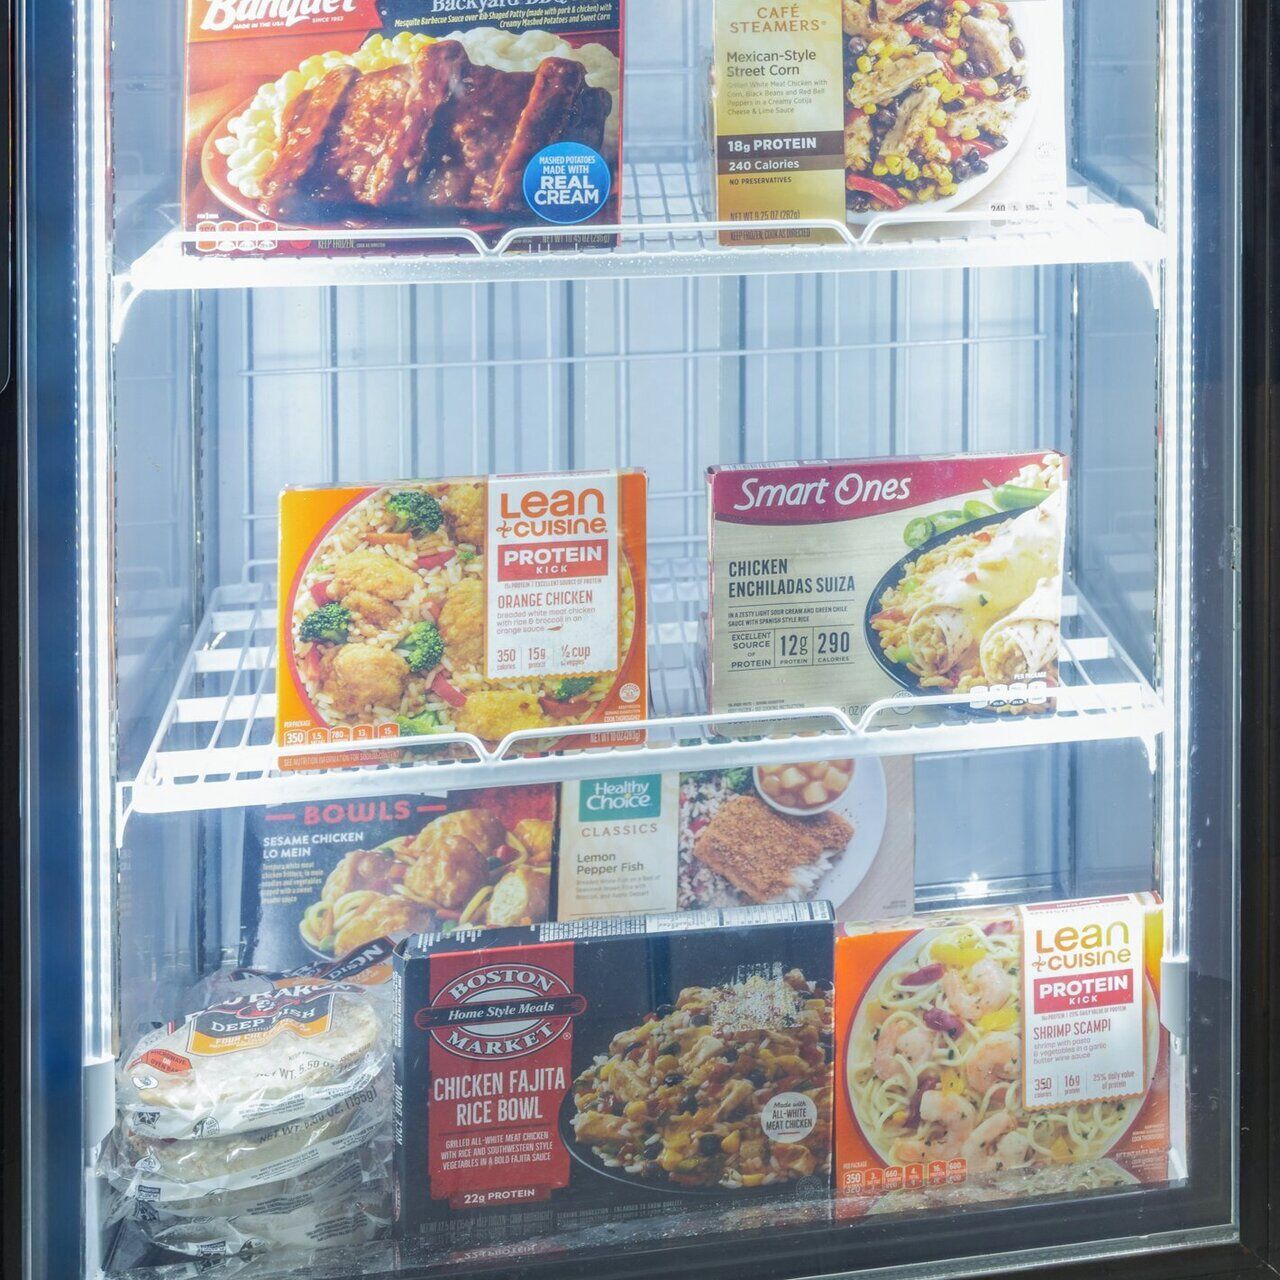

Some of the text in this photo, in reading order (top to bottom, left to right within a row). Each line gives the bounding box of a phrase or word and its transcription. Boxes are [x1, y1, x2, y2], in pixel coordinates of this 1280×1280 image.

[757, 3, 800, 19] CAFÉ
[729, 20, 820, 33] STEAMERS
[726, 49, 816, 64] Mexican-Style
[726, 64, 800, 77] Street Corn
[728, 137, 817, 153] 18g PROTEIN
[729, 159, 800, 171] 240 Calories
[540, 175, 595, 190] REAL
[534, 190, 599, 205] CREAM
[733, 473, 912, 511] Smart Ones
[500, 488, 605, 519] Lean
[504, 546, 602, 567] PROTEIN
[536, 565, 568, 574] KICK
[729, 558, 788, 577] CHICKEN
[728, 575, 855, 598] ENCHILADAS SUIZA
[498, 590, 593, 610] ORANGE CHICKEN
[733, 641, 770, 650] SOURCE
[780, 634, 808, 656] 12g
[818, 631, 850, 654] 290
[593, 780, 650, 795] Healthy
[586, 794, 652, 811] Choice
[304, 799, 412, 826] BOWLS
[581, 822, 658, 838] CLASSICS
[263, 832, 364, 847] SESAME CHICKEN
[263, 847, 311, 859] LO MEIN
[577, 853, 616, 863] Lemon
[577, 861, 644, 876] Pepper Fish
[1036, 920, 1129, 954] Lean
[448, 969, 555, 1001] BOSTON
[1039, 974, 1128, 999] PROTEIN
[448, 1002, 555, 1021] Home Style Meals
[1033, 1018, 1111, 1040] SHRIMP SCAMPI
[446, 1022, 554, 1055] MARKET
[434, 1066, 566, 1101] CHICKEN FAJITA
[456, 1096, 543, 1127] RICE BOWL
[464, 1189, 535, 1205] 22g PROTEIN
